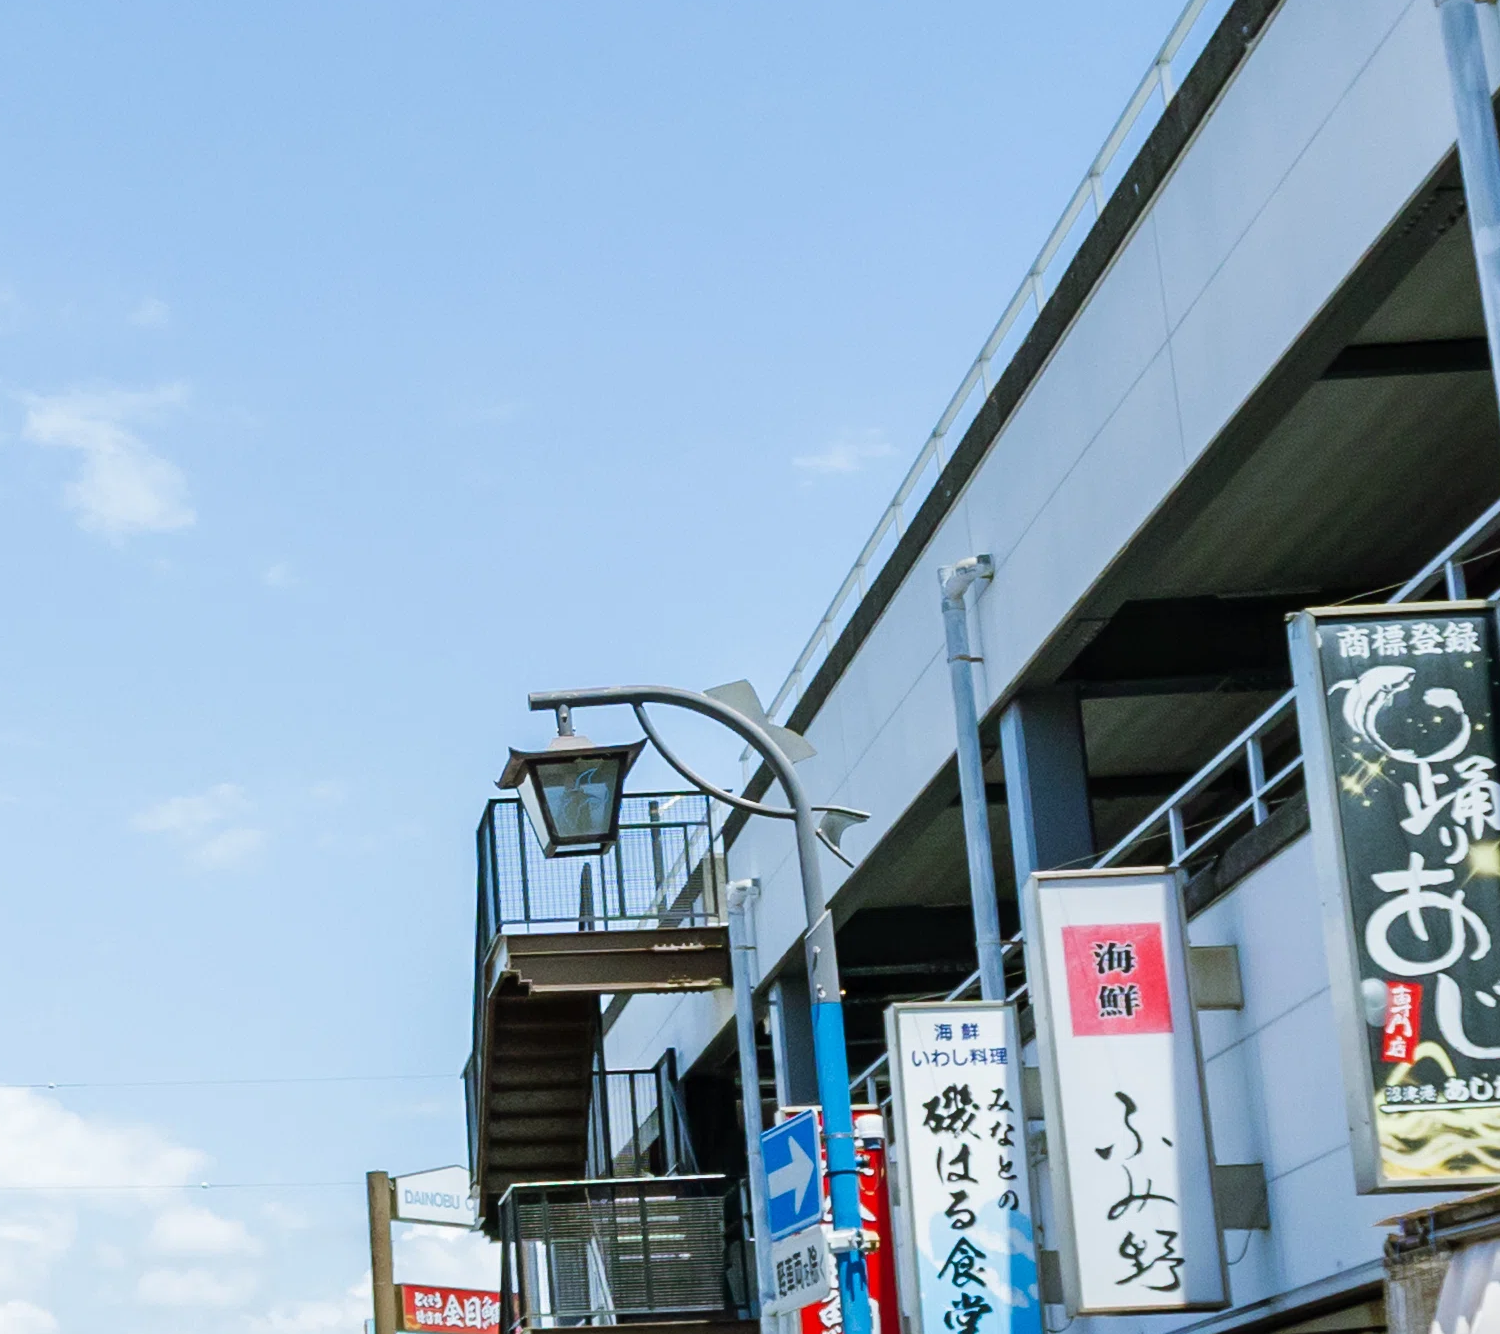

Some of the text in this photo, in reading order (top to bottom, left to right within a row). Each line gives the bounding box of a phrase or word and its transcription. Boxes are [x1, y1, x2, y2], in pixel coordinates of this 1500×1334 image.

[1338, 620, 1482, 658] 商標登録
[1093, 941, 1142, 1018] 海鮮
[934, 1023, 980, 1041] 海鮮
[911, 1047, 1008, 1067] いわし料理
[987, 1087, 1020, 1211] みなとの
[404, 1189, 460, 1209] DAINOBU
